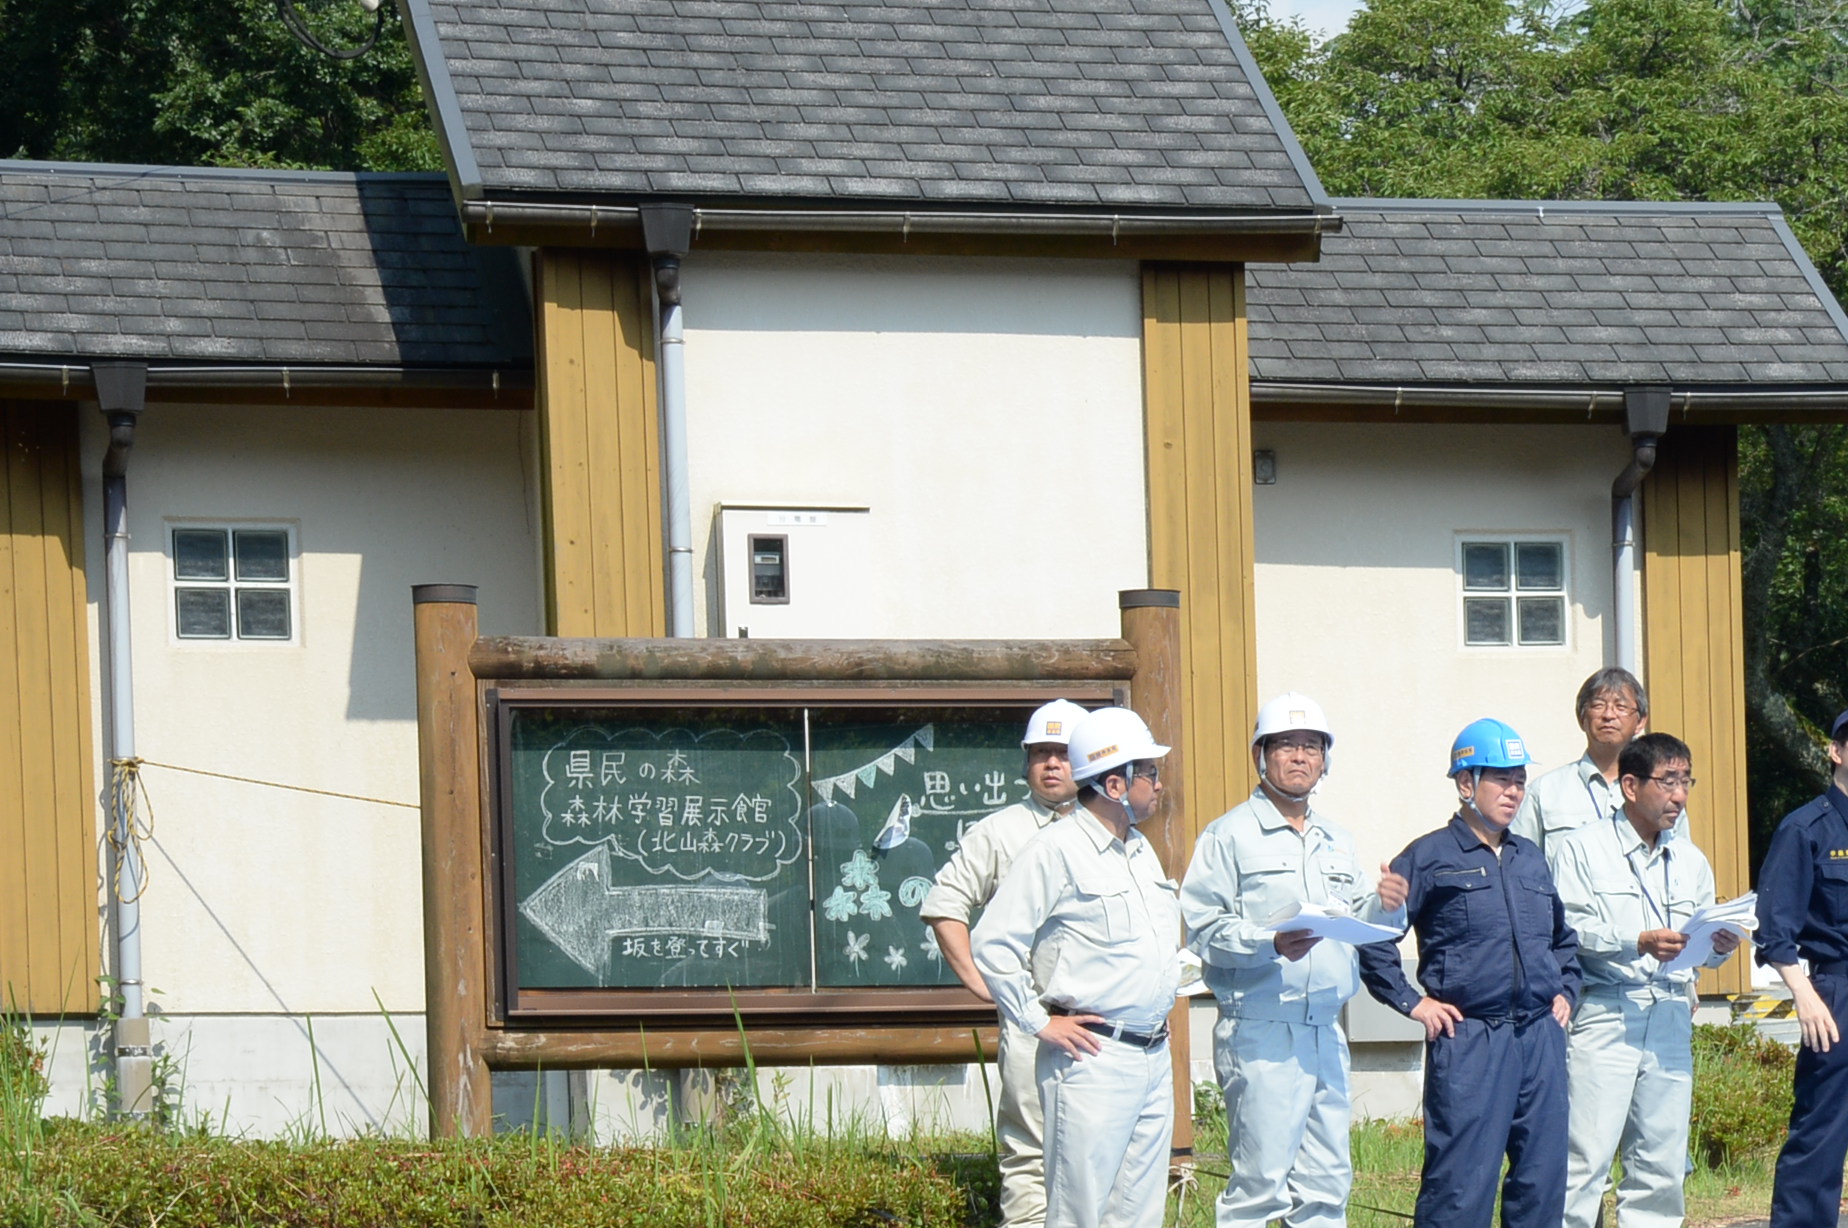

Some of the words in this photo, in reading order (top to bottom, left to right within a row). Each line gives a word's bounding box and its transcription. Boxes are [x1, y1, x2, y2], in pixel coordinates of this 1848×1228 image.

[565, 749, 701, 789] 県民の森
[560, 791, 772, 828] 森林学習展示館
[637, 827, 787, 858] (北山森クラブ)
[621, 935, 750, 959] 坂を登ってすぐ
